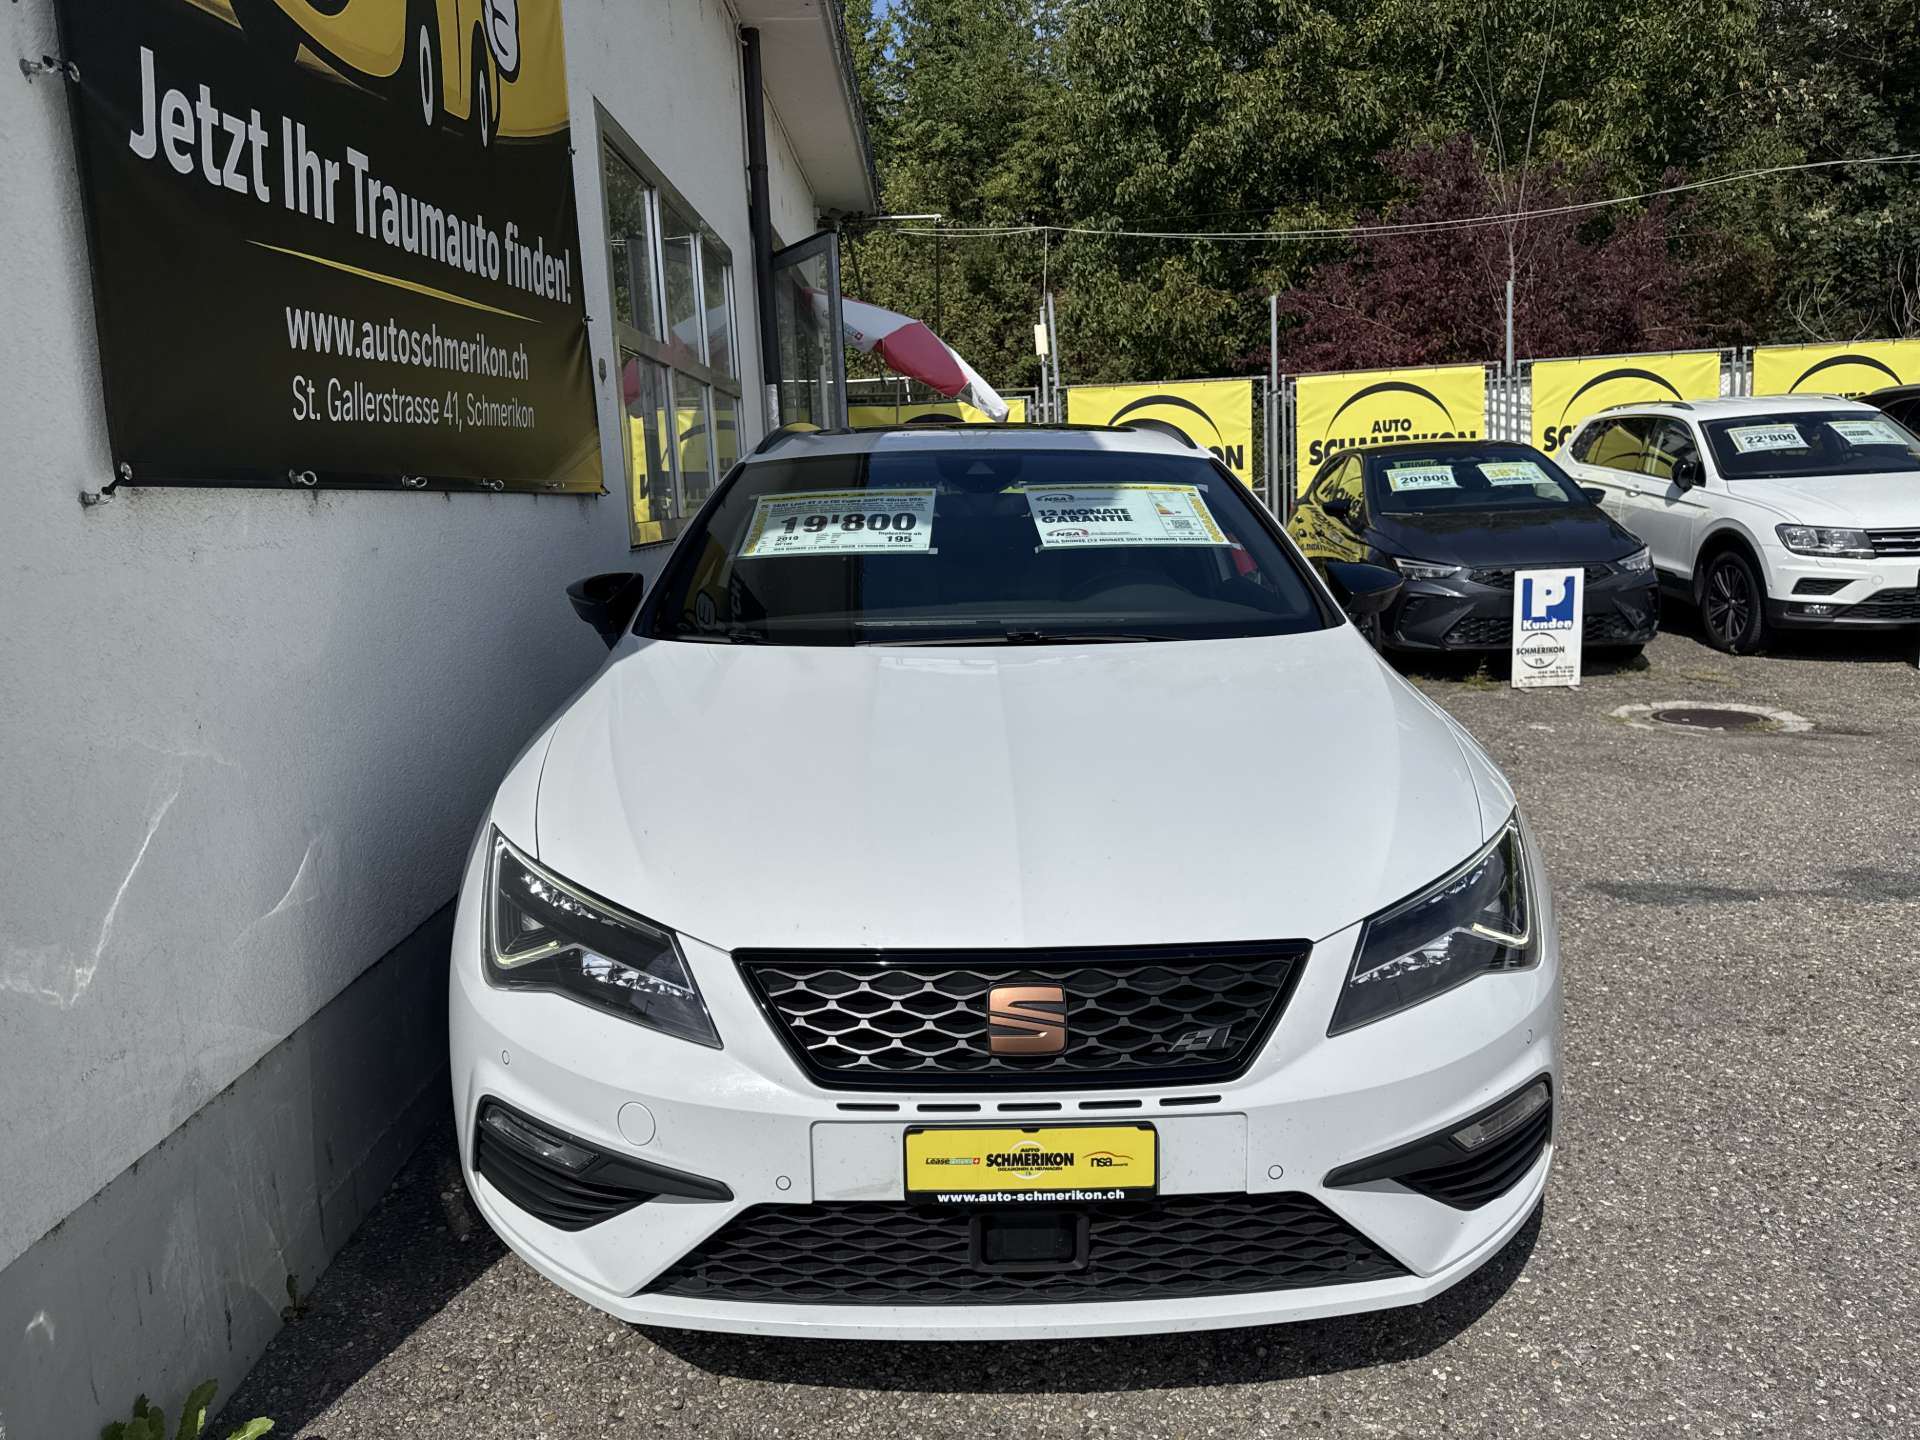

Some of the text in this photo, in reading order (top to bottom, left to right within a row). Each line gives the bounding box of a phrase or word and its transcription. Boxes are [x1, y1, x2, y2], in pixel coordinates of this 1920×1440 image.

[129, 46, 572, 304] Jetzt Ihr Traumauto finden!
[286, 306, 529, 381] www.autoschmerikon.ch
[292, 375, 535, 432] St. Gallerstrasse 41, Schmerikon
[1371, 418, 1412, 434] AUTO
[1744, 433, 1797, 444] 22'800
[1401, 474, 1449, 484] 20'800
[1038, 508, 1131, 517] 12 MONATE
[1041, 514, 1133, 523] GARANTIE
[781, 512, 917, 534] 19'800
[887, 535, 912, 543] 195
[1531, 576, 1566, 617] P
[1522, 617, 1573, 631] Kunden
[1516, 645, 1565, 656] SCHMERIKON
[986, 1152, 1074, 1167] SCHMERIKON
[1091, 1156, 1113, 1168] nsa
[937, 1188, 1125, 1202] www.auto-schmerikon.ch
